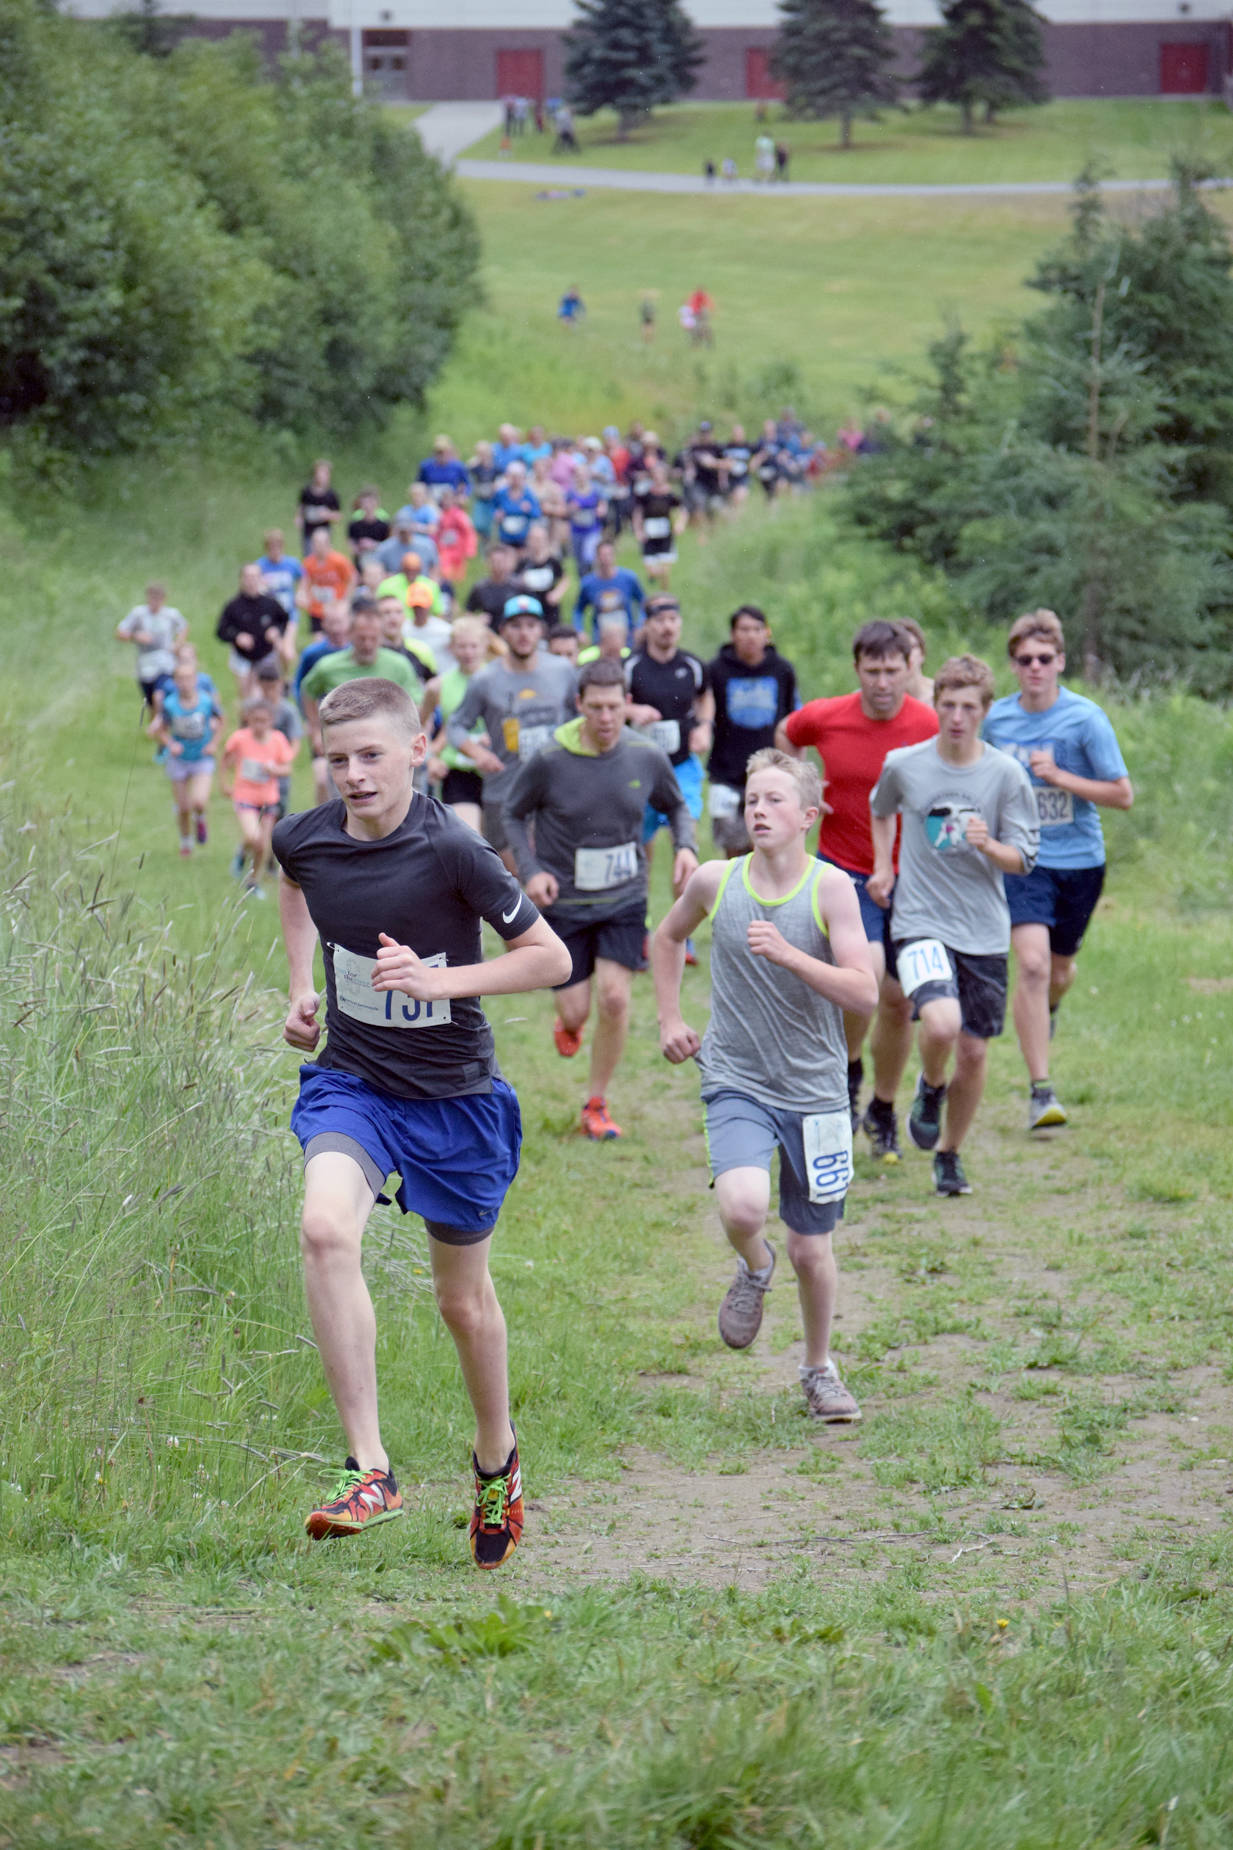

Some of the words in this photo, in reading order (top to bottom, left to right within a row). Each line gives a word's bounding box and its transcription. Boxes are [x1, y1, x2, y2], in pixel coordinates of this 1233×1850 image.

[1037, 791, 1069, 820] 632
[604, 848, 632, 885] 744
[907, 946, 944, 980] 714
